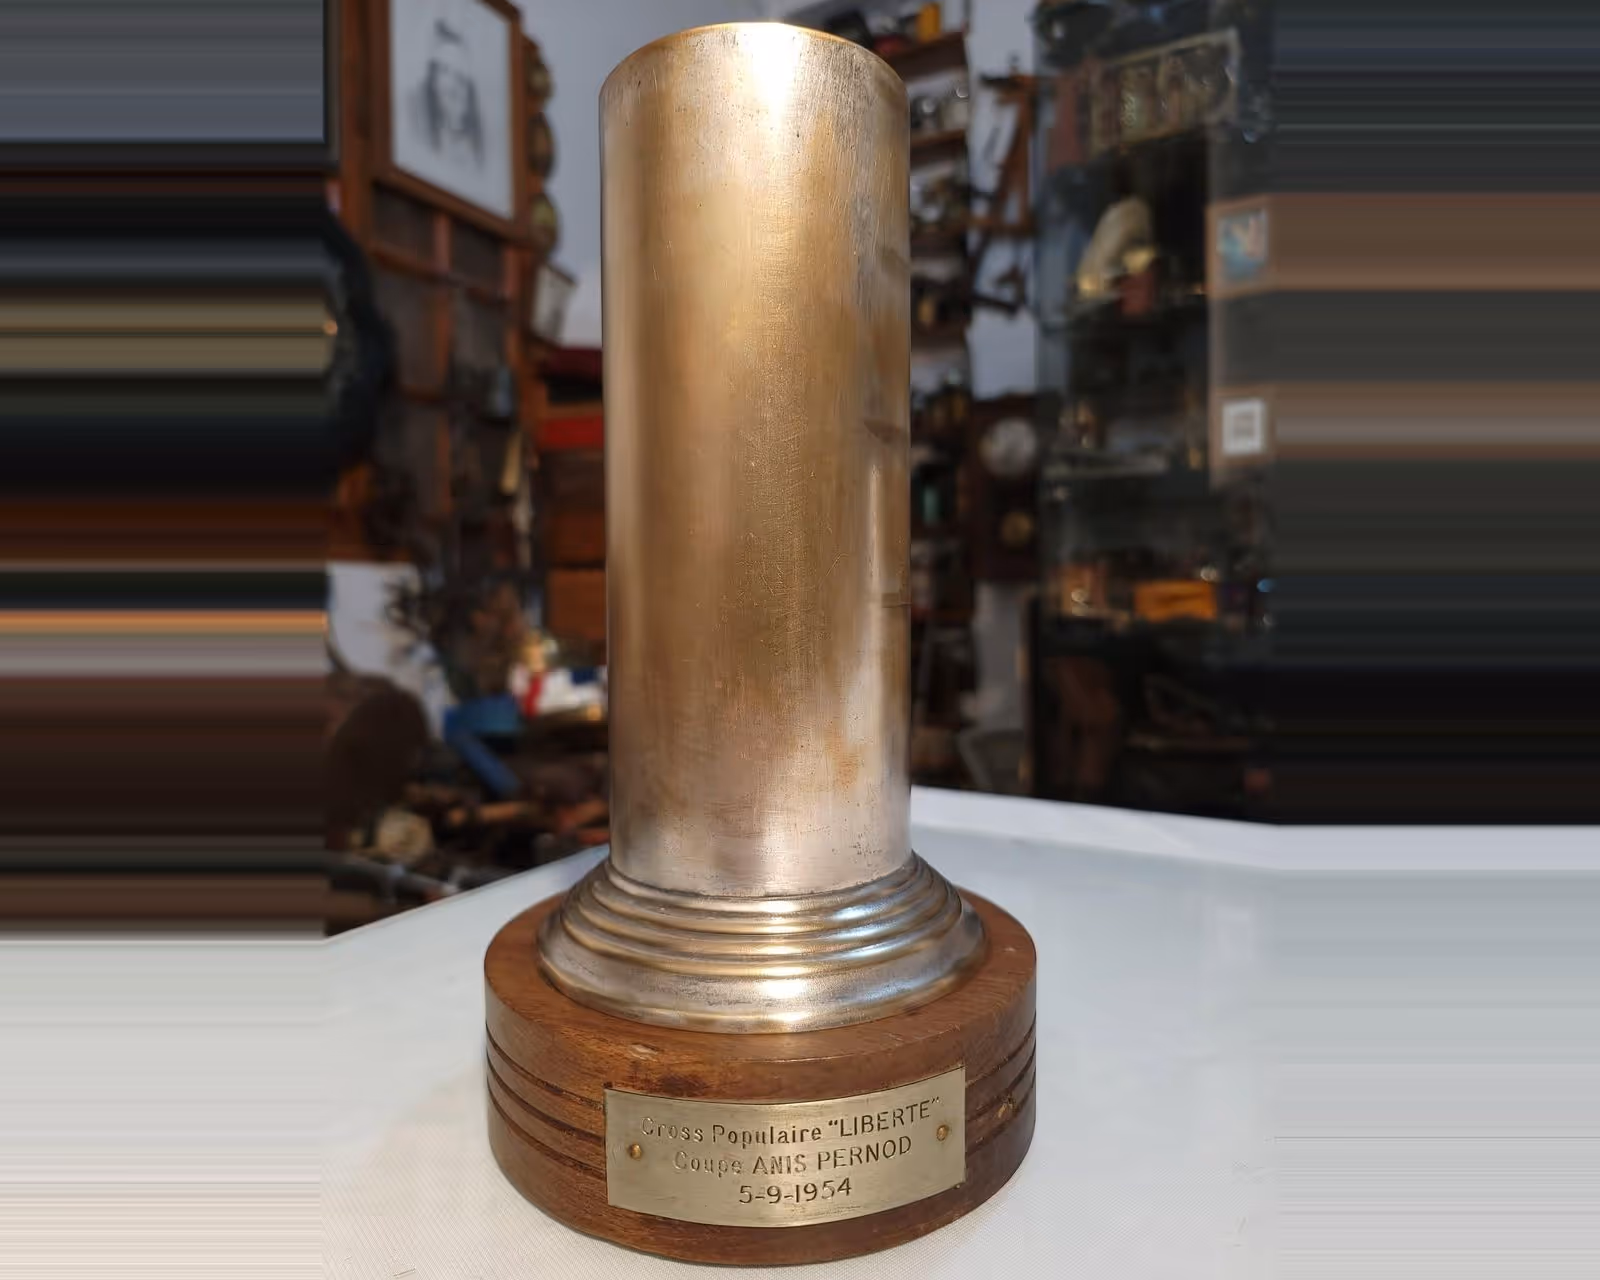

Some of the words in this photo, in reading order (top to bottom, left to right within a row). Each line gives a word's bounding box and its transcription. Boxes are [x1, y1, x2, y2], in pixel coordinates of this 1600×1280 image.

[641, 1117, 704, 1143] Cross
[712, 1124, 823, 1150] Populaire
[673, 1150, 743, 1179] Coupe
[752, 1154, 807, 1175] ANIS
[817, 1135, 912, 1170] PERNOD
[739, 1176, 853, 1205] 5-9-1954
